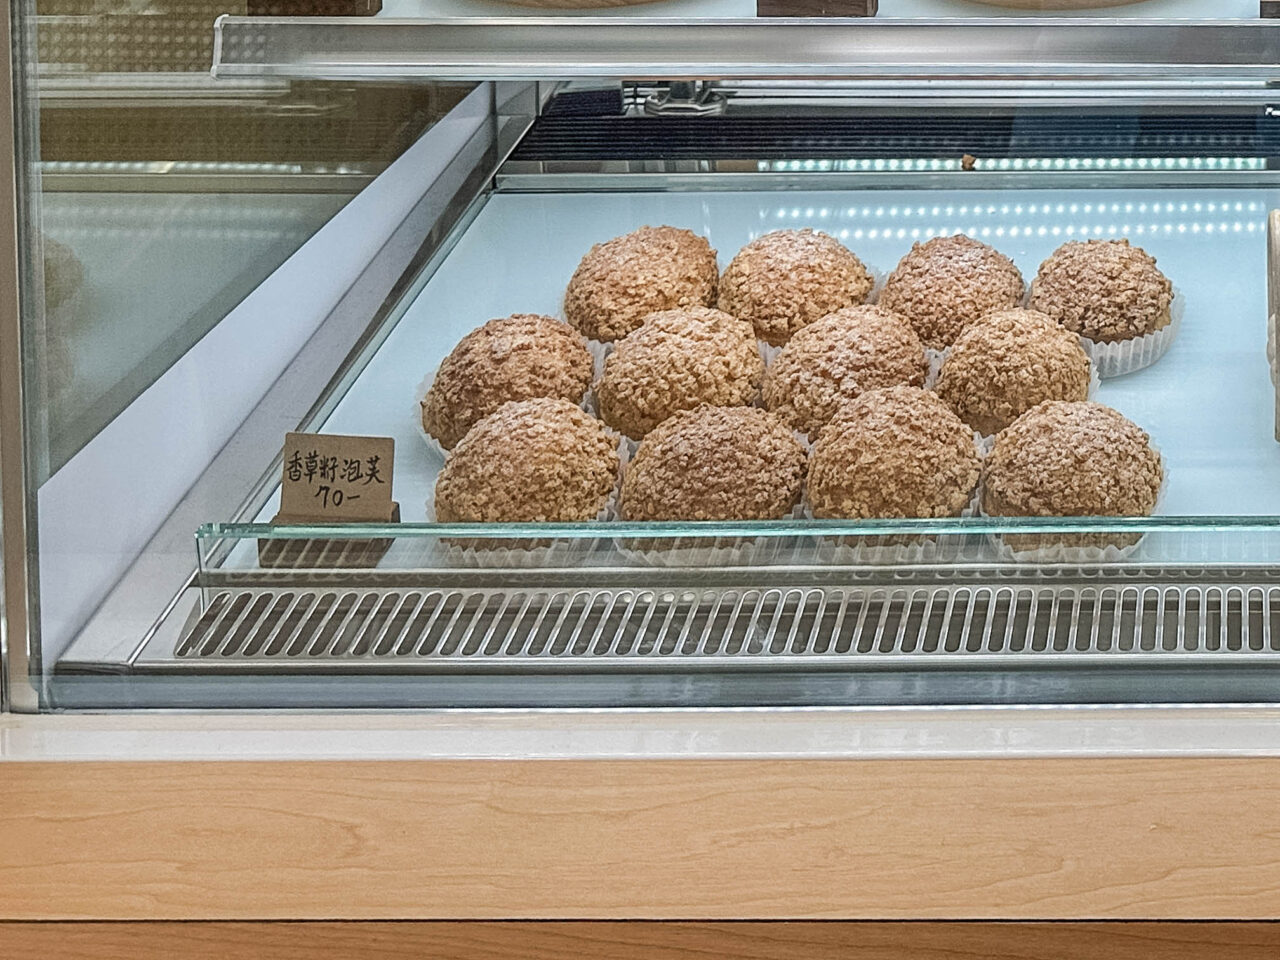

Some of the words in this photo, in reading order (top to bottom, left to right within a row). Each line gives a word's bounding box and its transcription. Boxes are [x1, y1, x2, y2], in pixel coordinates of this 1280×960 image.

[287, 450, 385, 486] 香草籽泡芙
